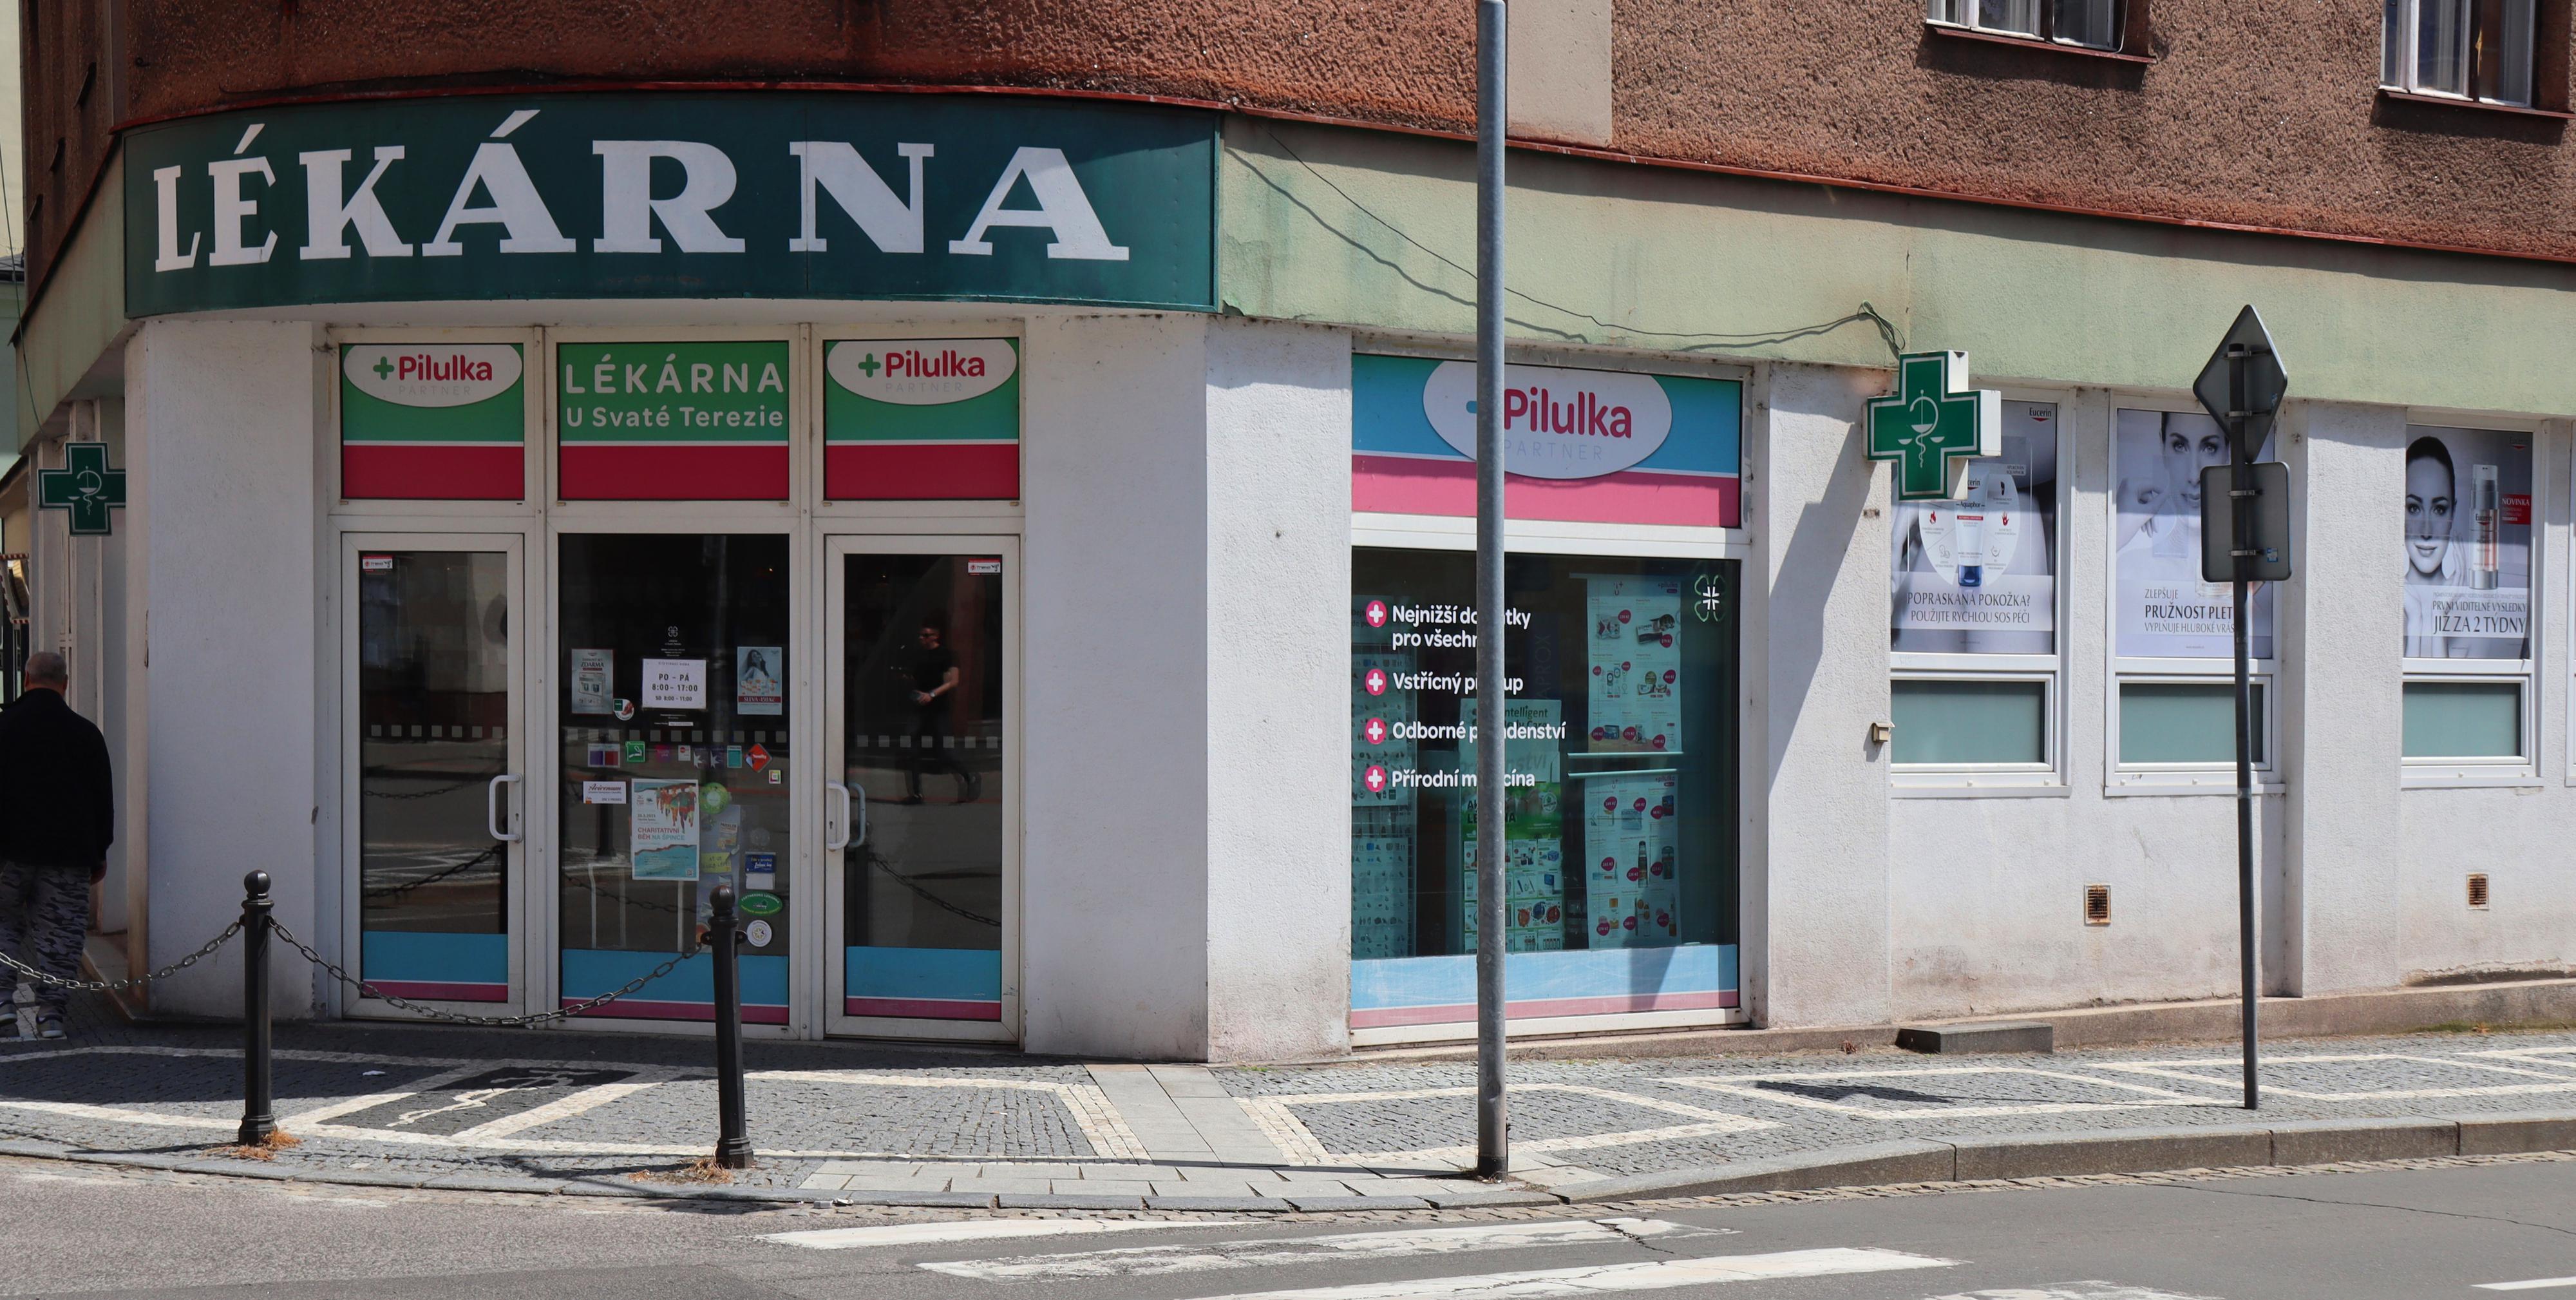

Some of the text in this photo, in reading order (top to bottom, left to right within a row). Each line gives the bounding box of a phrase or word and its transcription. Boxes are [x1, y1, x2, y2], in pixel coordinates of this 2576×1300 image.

[154, 110, 1129, 271] LÉKÁRNA
[399, 354, 492, 381] Pilulka
[886, 350, 985, 378] Pilulka
[565, 354, 784, 394] LÉKÁRNA
[399, 386, 471, 396] PARTNER
[886, 383, 961, 392] PARTNER
[567, 405, 783, 427] U Svaté Terezie
[1504, 387, 1631, 439] Pilulka
[2029, 406, 2051, 417] Eucerin
[1504, 439, 1602, 460] PARTNER
[2502, 497, 2530, 507] NOVINKA
[1908, 590, 2031, 607] POPRASKANÁ POKOŽKA?
[2145, 587, 2179, 600] ZLEPŠUJE
[1392, 604, 1457, 627] Nejnižší
[1459, 606, 1531, 629] dotky
[1911, 609, 2030, 624] POUŽIJTE RYCHLOU SOS PÉČI
[2145, 602, 2233, 619] PRUŽNOST PLET
[2145, 620, 2180, 634] VYPLŇUJE
[2181, 620, 2215, 633] HLUBOKÉ
[2434, 611, 2527, 635] JIŽ ZA 2 TÝDNY
[1392, 633, 1421, 651] pro
[679, 673, 690, 682] PÁ
[1393, 671, 1462, 694] Vstřícný
[1505, 705, 1548, 720] ntelligent
[1392, 721, 1567, 743] Odborné pdenství
[1392, 769, 1535, 788] Přírodní mcína
